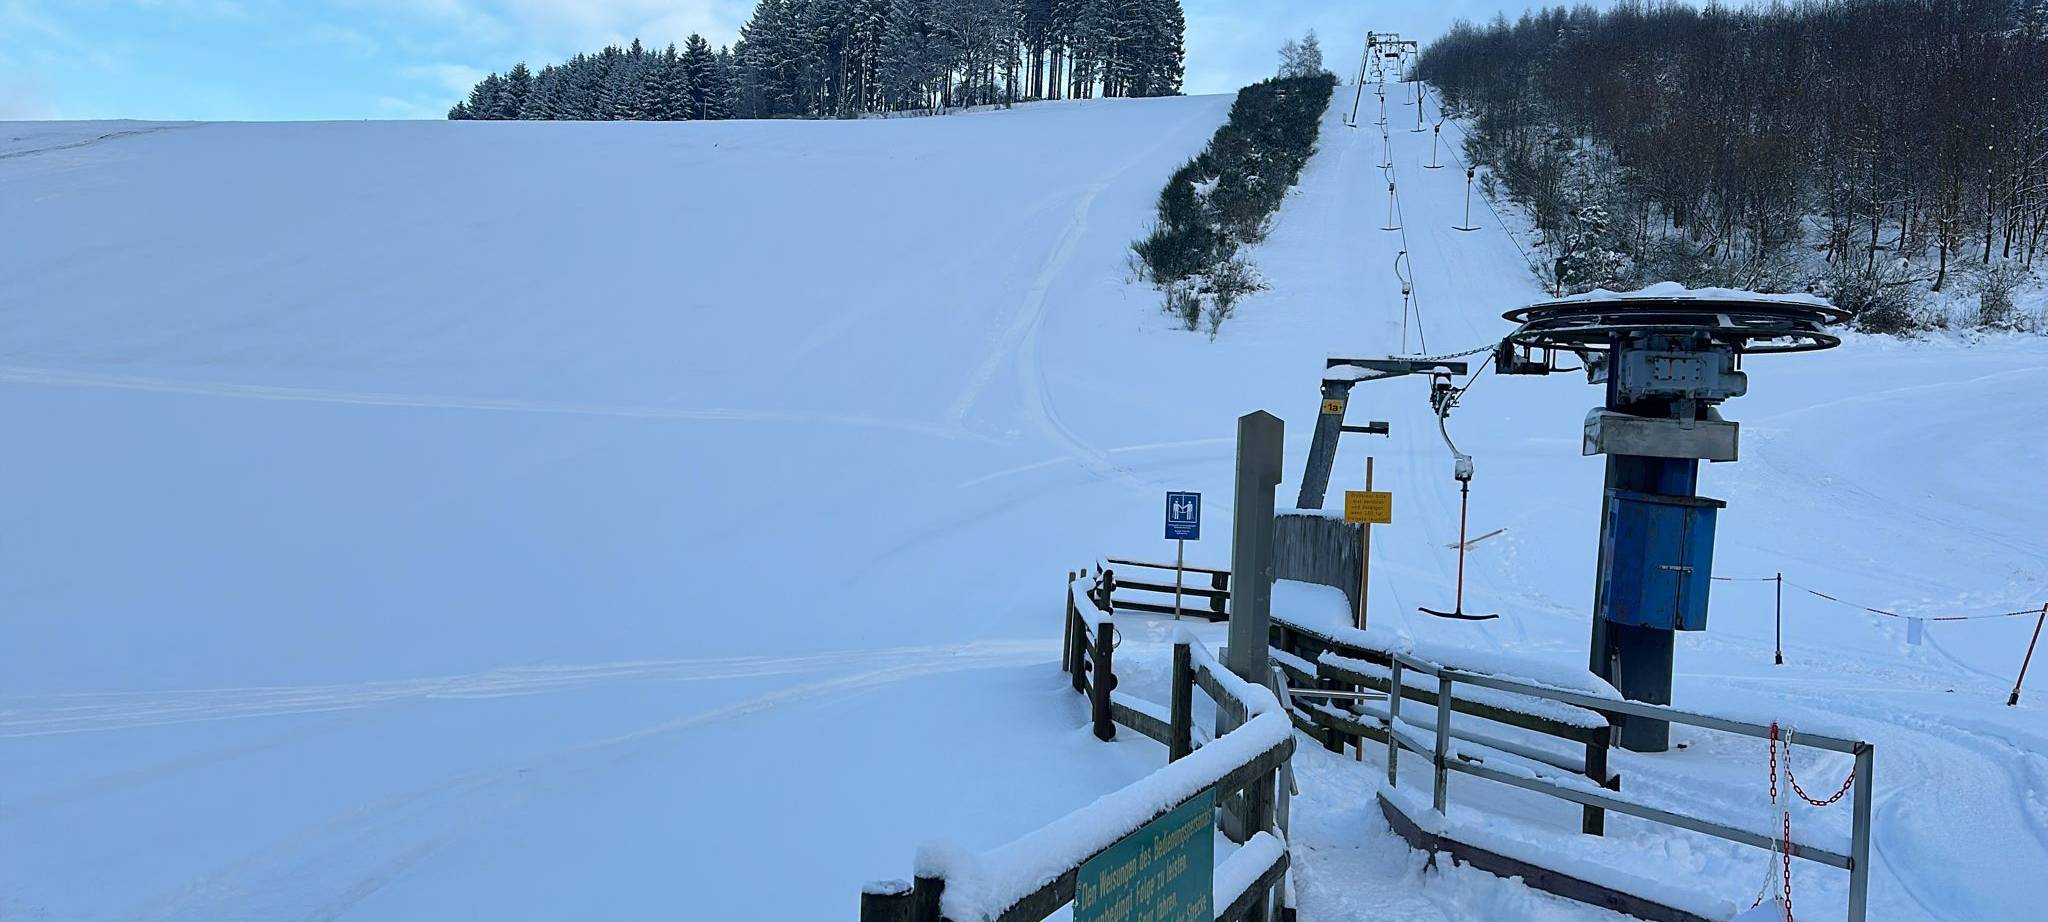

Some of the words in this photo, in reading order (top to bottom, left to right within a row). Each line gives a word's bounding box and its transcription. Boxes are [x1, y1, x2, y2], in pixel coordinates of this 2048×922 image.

[1328, 403, 1338, 411] 1a
[1081, 881, 1097, 911] Den
[1100, 857, 1137, 898] Weisungen
[1139, 845, 1151, 871] des
[1136, 876, 1154, 906] Folge
[1157, 870, 1165, 890] zu
